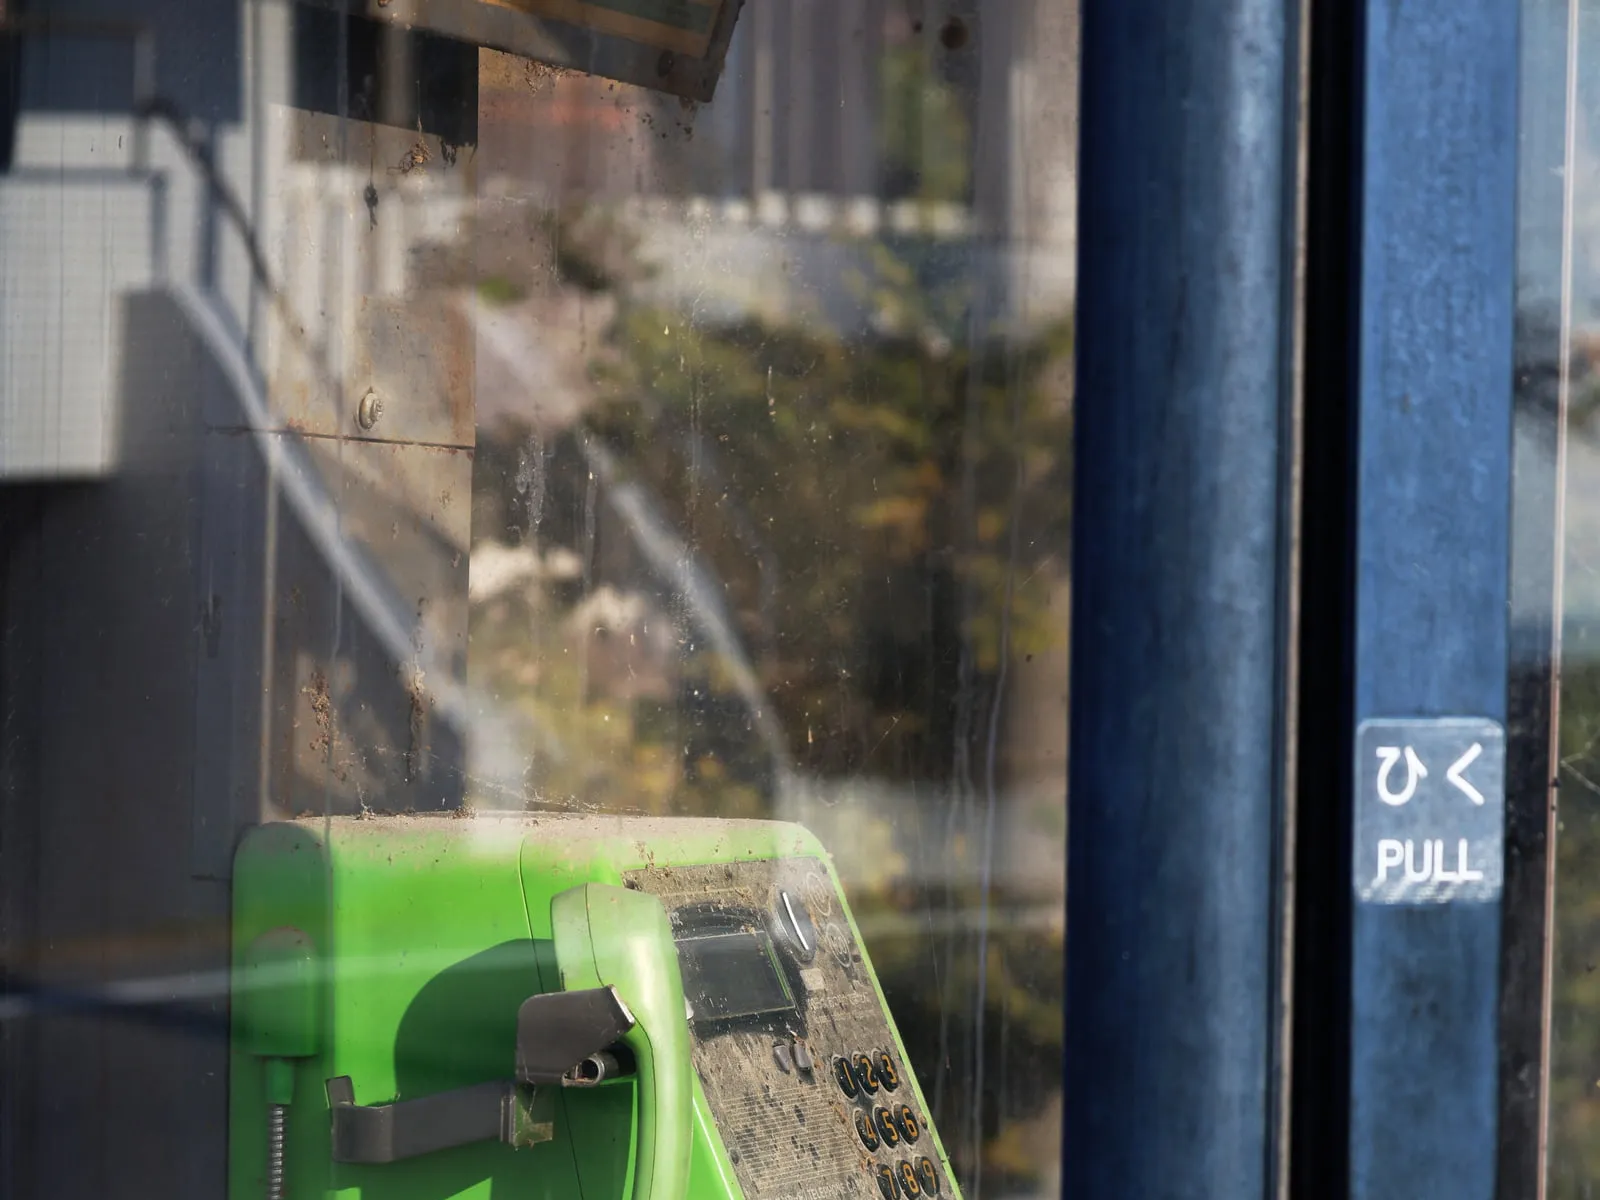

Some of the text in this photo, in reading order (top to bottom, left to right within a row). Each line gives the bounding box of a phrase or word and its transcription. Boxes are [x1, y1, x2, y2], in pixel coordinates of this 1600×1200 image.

[1375, 741, 1486, 807] ひく
[1377, 837, 1484, 883] PULL
[842, 1054, 897, 1090] 1 2 3
[864, 1107, 918, 1141] 4 5 6
[882, 1159, 938, 1199] 7 8 9
